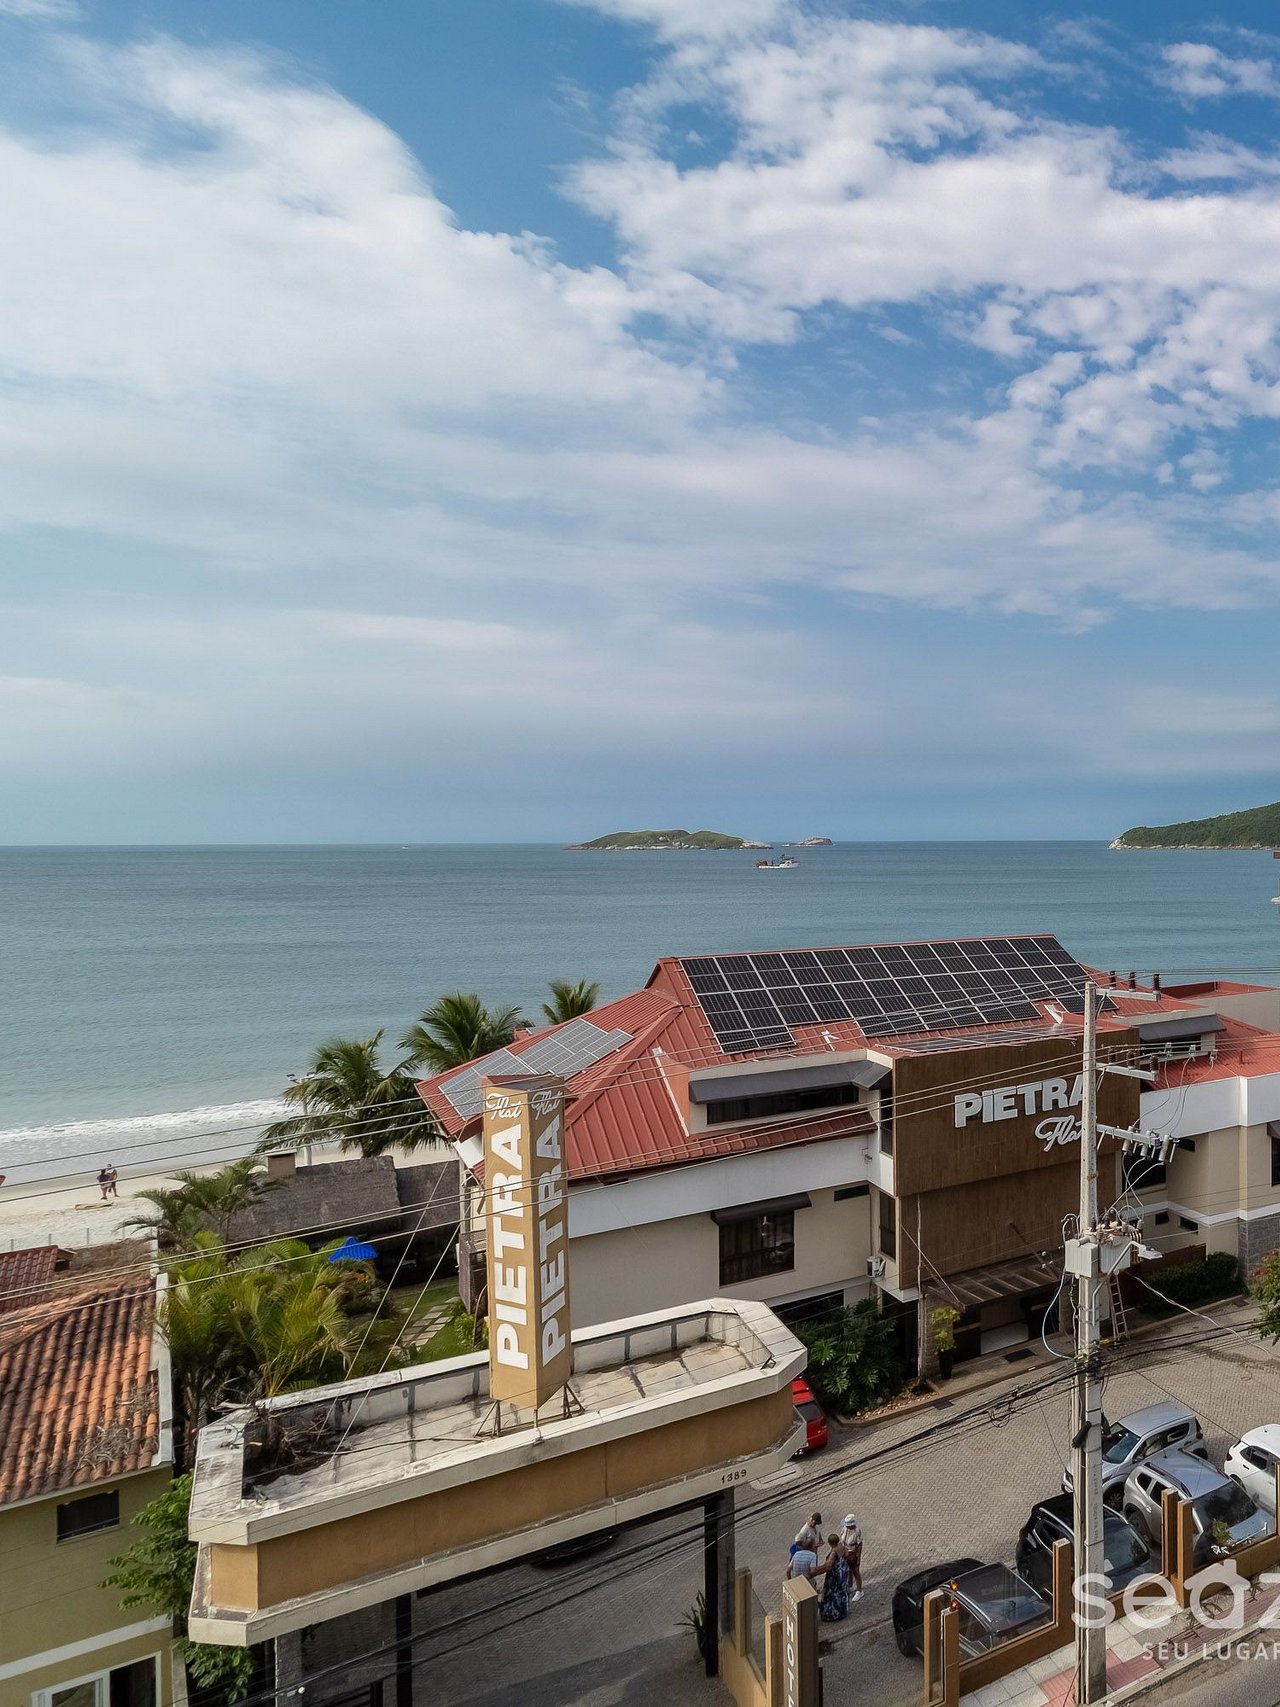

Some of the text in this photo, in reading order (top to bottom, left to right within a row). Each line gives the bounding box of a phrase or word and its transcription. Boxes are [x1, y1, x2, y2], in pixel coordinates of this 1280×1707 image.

[485, 1092, 522, 1120] Flat
[531, 1090, 563, 1120] Flat
[490, 1124, 529, 1370] PIETRA
[536, 1114, 566, 1368] PIETRA
[721, 1469, 747, 1484] 1389
